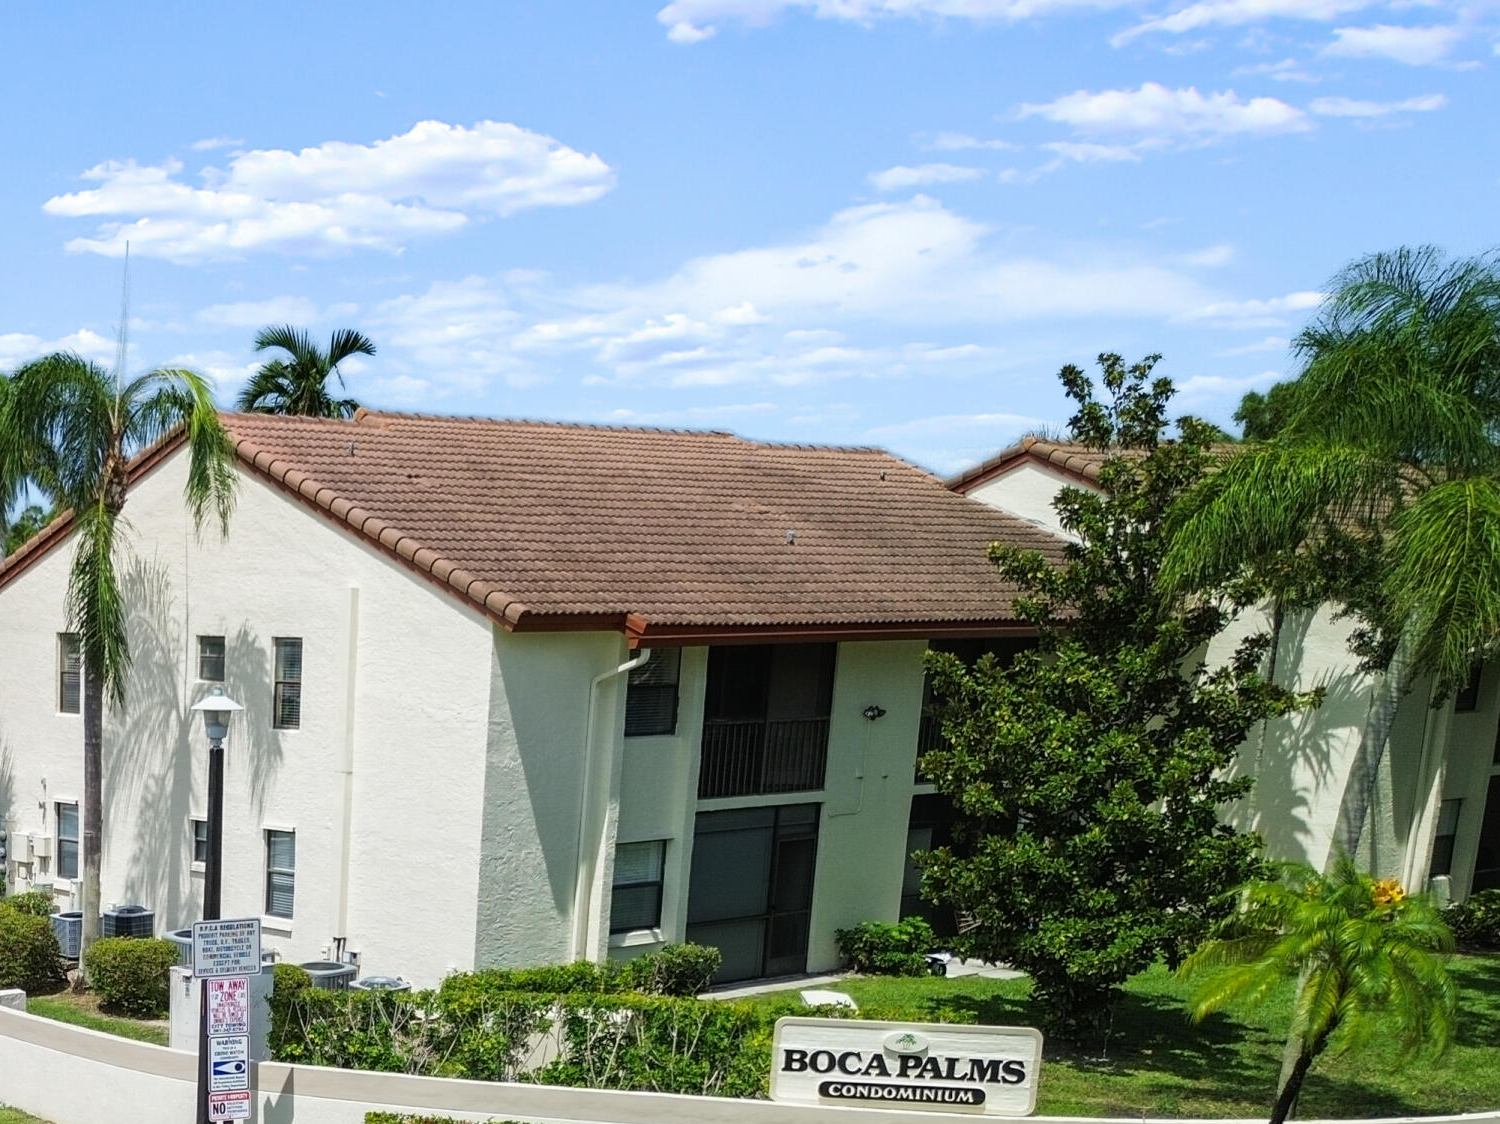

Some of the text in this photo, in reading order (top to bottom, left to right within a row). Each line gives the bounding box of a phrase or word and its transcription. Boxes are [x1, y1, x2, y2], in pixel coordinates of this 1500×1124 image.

[211, 980, 245, 992] TOW AWAY
[220, 991, 236, 1001] ZONE
[781, 1049, 1026, 1084] BOCA PALMS
[828, 1083, 974, 1102] CONDOMINIUM
[213, 1102, 226, 1115] NO
